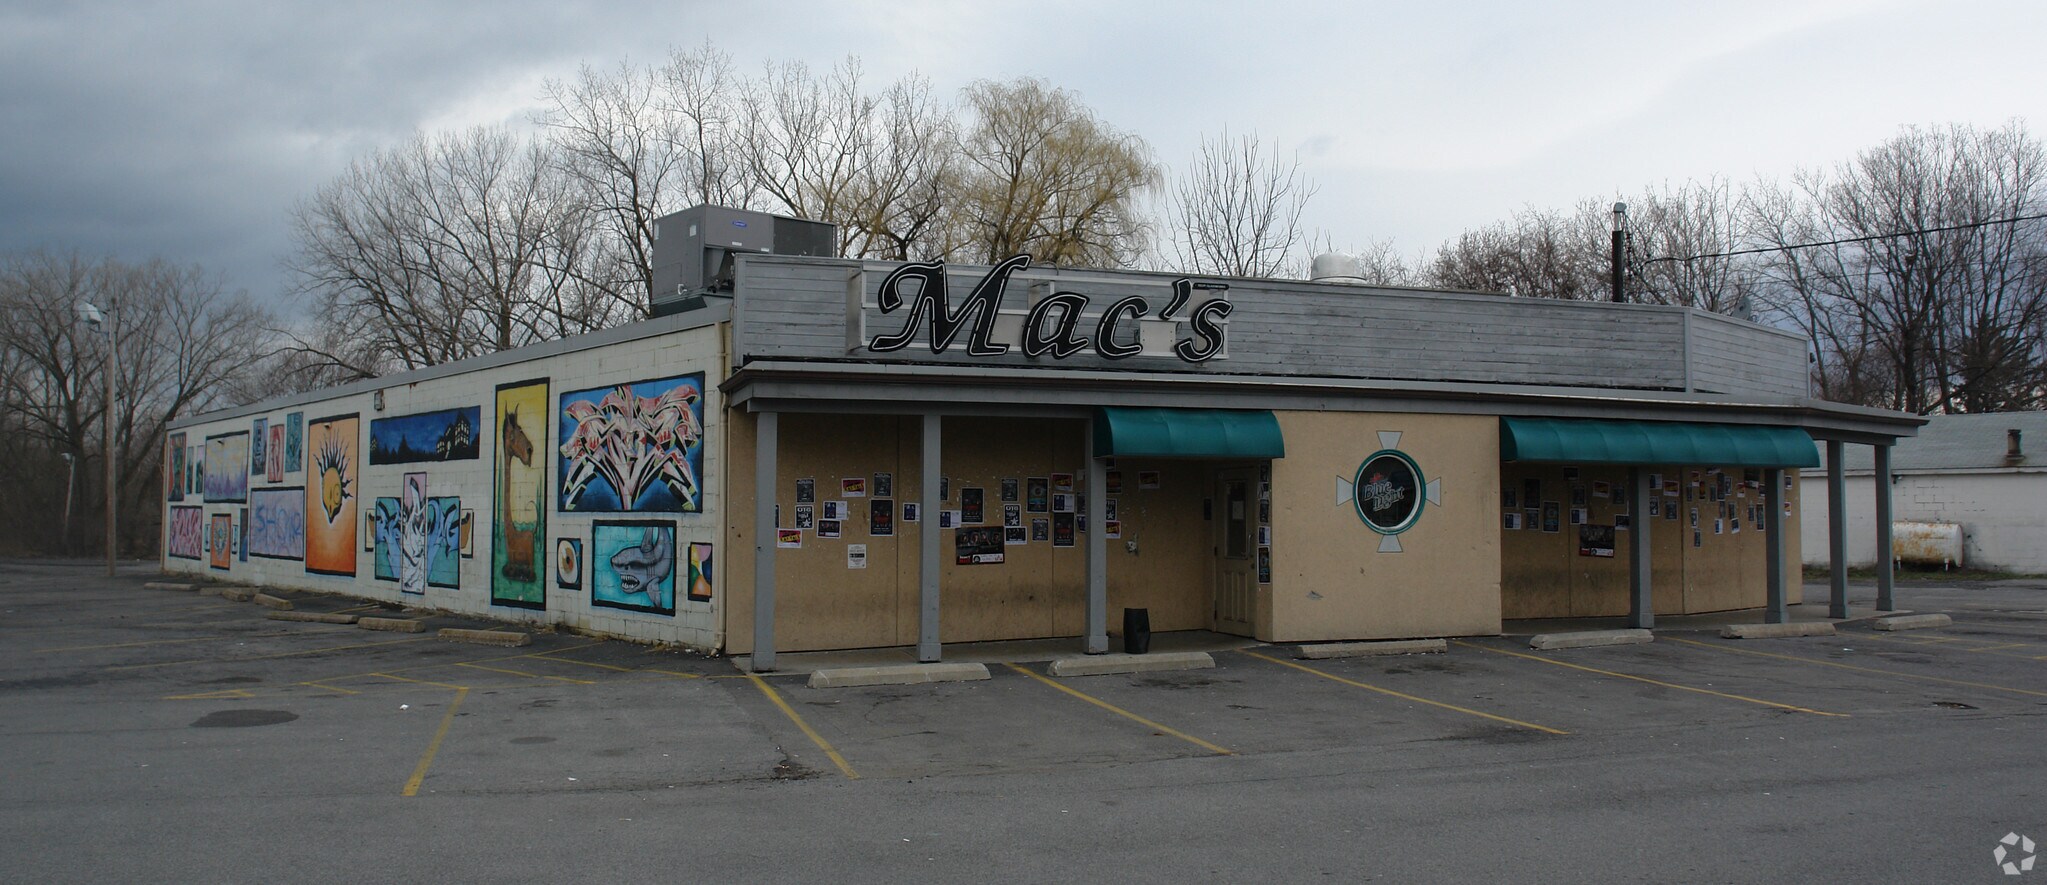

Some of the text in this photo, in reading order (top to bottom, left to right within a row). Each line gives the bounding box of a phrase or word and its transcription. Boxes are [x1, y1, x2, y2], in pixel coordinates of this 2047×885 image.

[868, 253, 1233, 363] Mac's
[1363, 482, 1392, 501] Blue
[1373, 487, 1405, 511] Light
